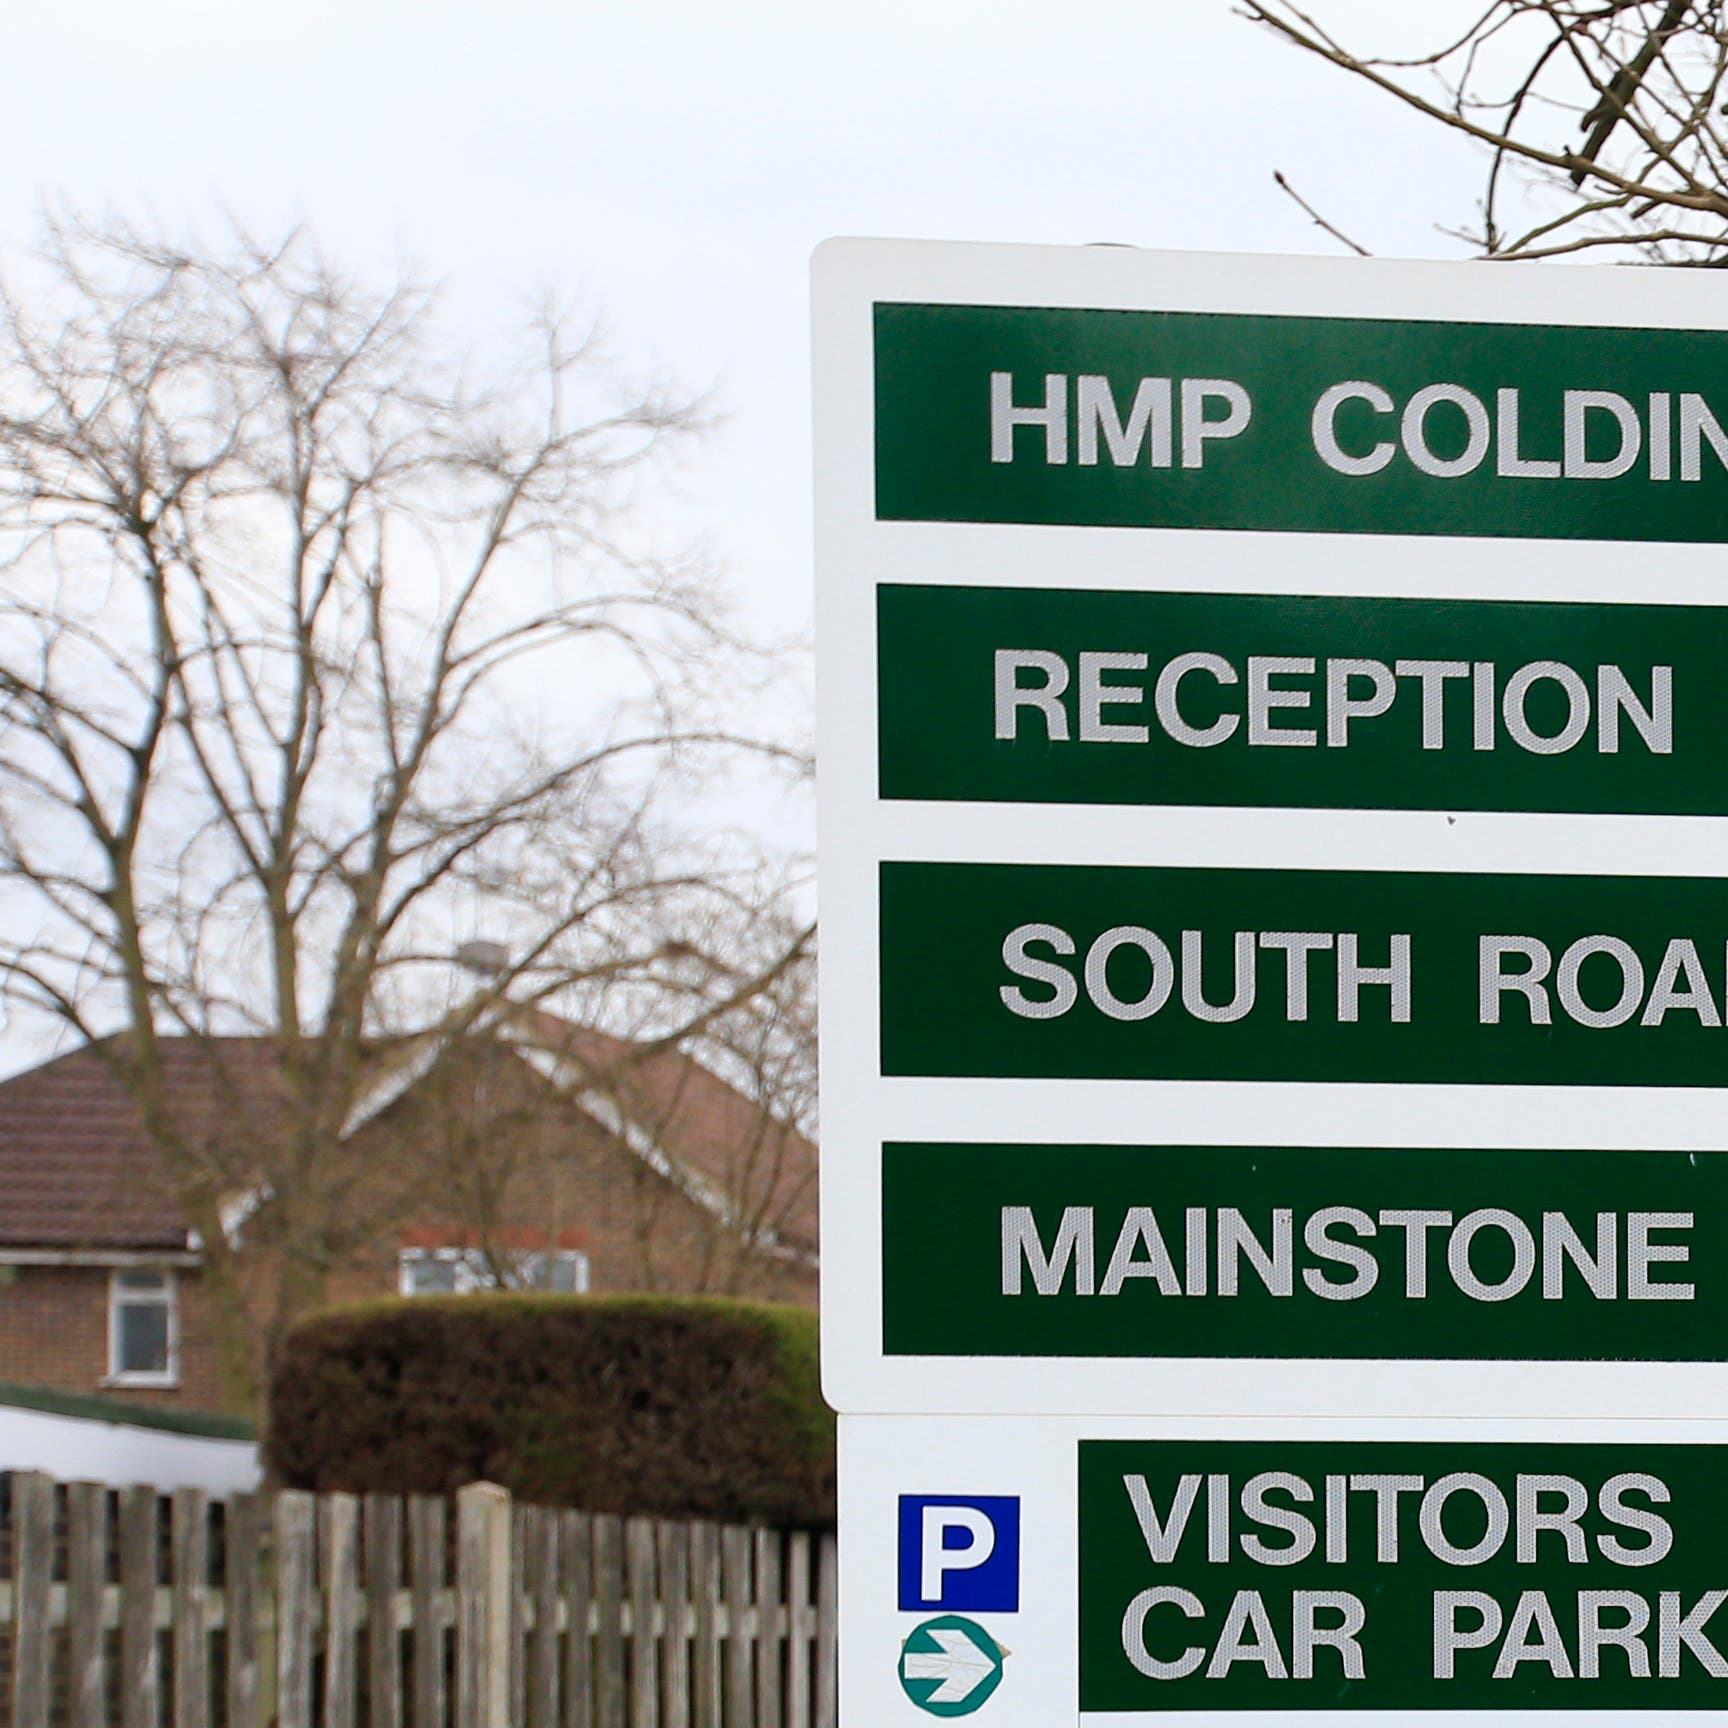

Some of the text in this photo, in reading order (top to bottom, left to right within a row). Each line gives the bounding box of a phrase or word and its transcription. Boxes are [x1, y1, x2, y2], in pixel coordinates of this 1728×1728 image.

[991, 372, 1252, 468] HMP
[995, 650, 1673, 754] RECEPTION
[1000, 924, 1410, 1022] SOUTH
[1002, 1207, 1695, 1301] MAINSTONE
[921, 1505, 995, 1601] P
[1123, 1472, 1673, 1566] VISITORS
[1122, 1586, 1366, 1680] CAR
